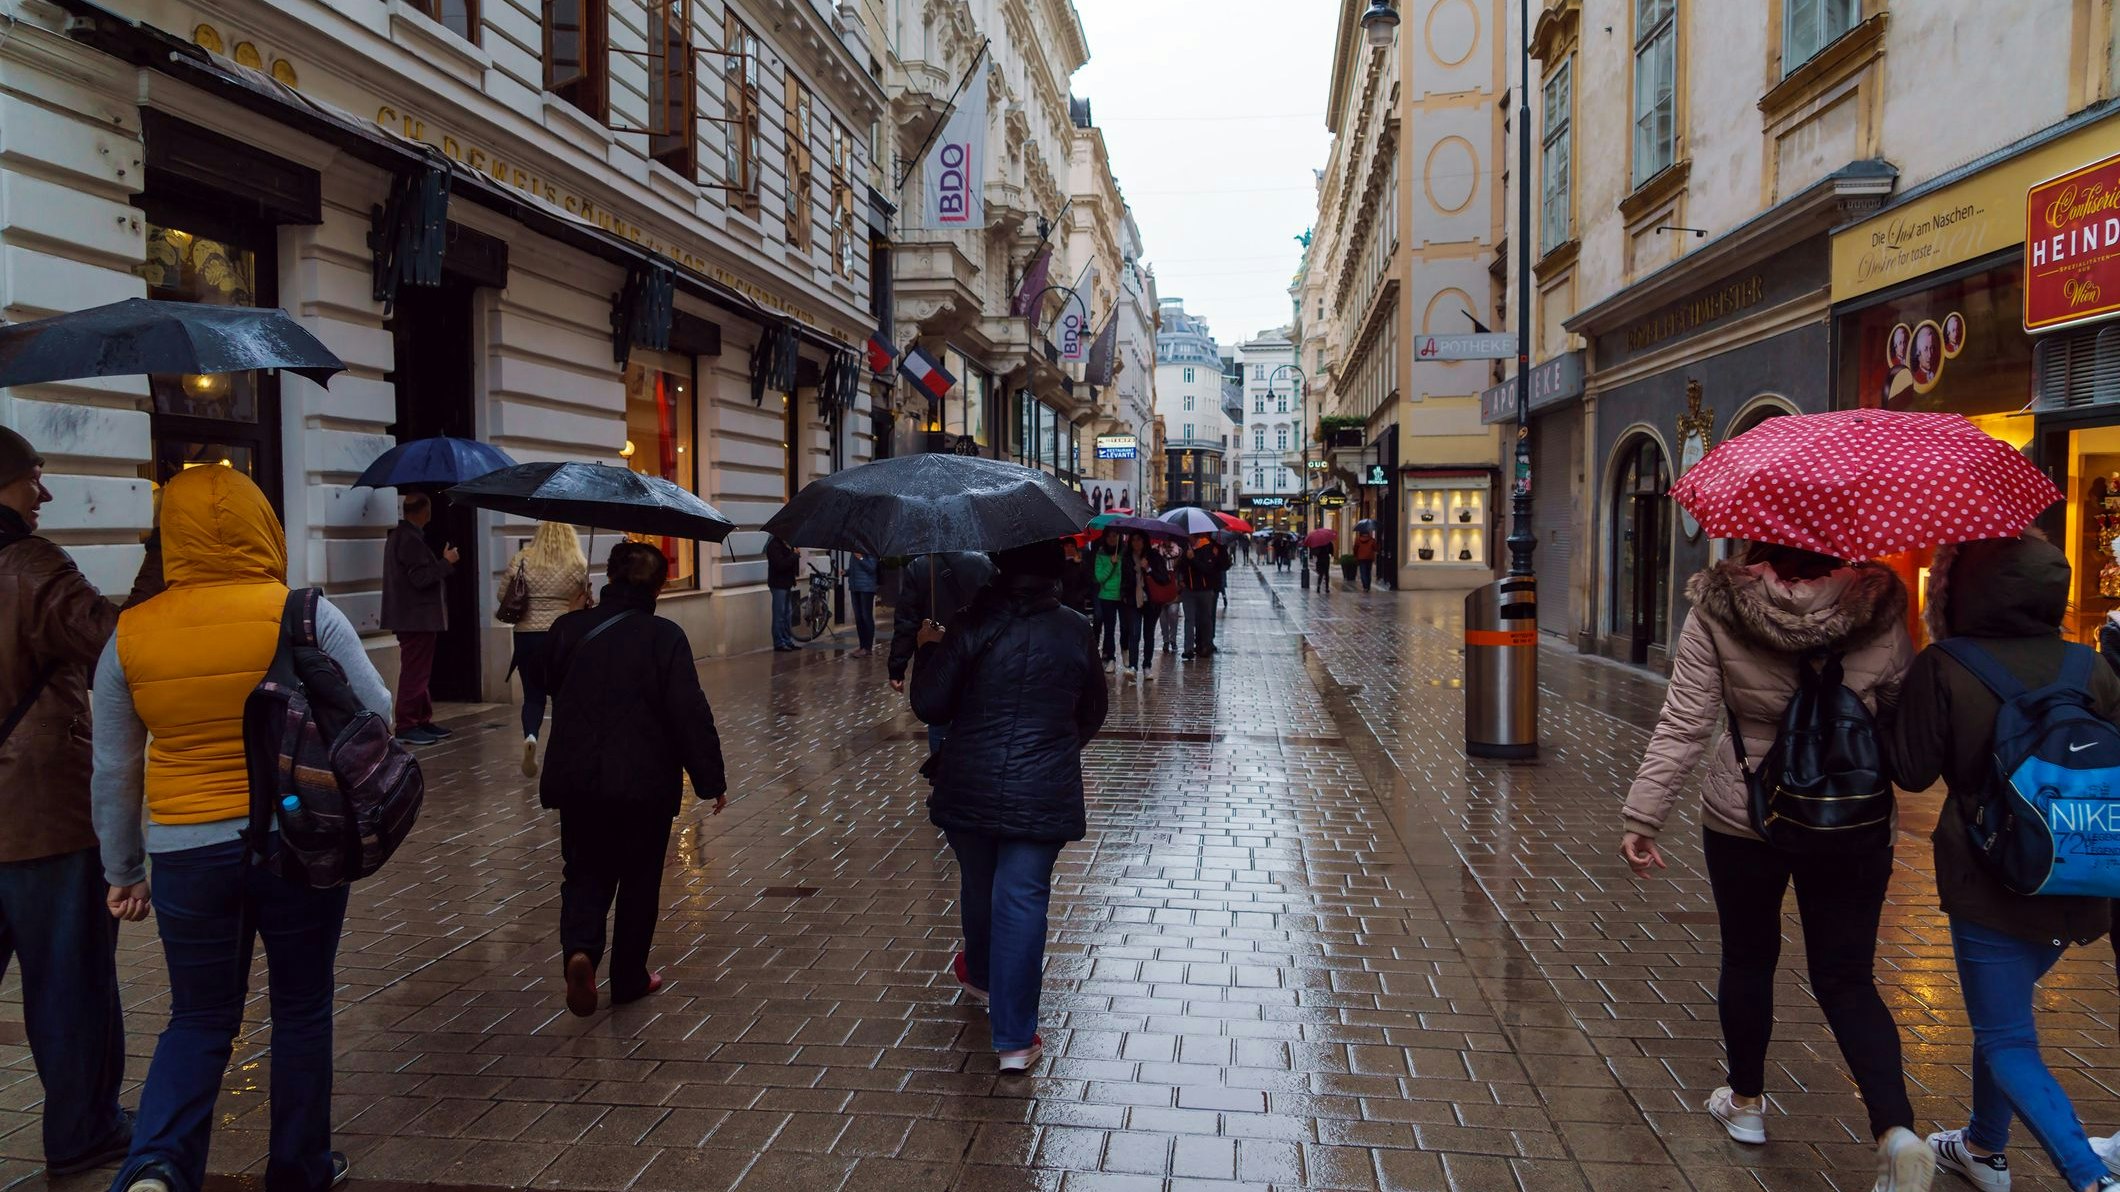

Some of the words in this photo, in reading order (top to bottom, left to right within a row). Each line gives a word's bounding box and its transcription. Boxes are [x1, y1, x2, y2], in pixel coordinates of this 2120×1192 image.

[940, 144, 964, 213] BDO
[1872, 232, 1885, 247] Die
[1916, 221, 1931, 237] am
[1932, 205, 1974, 229] Naschen
[1898, 249, 1909, 266] for
[1911, 245, 1932, 261] taste
[2063, 278, 2100, 308] Wien
[1064, 315, 1078, 353] BDO
[1421, 337, 1511, 357] APOTHEKE
[1494, 362, 1561, 415] APOEKE
[1253, 498, 1284, 506] WAGNER
[2052, 803, 2120, 832] NIKE
